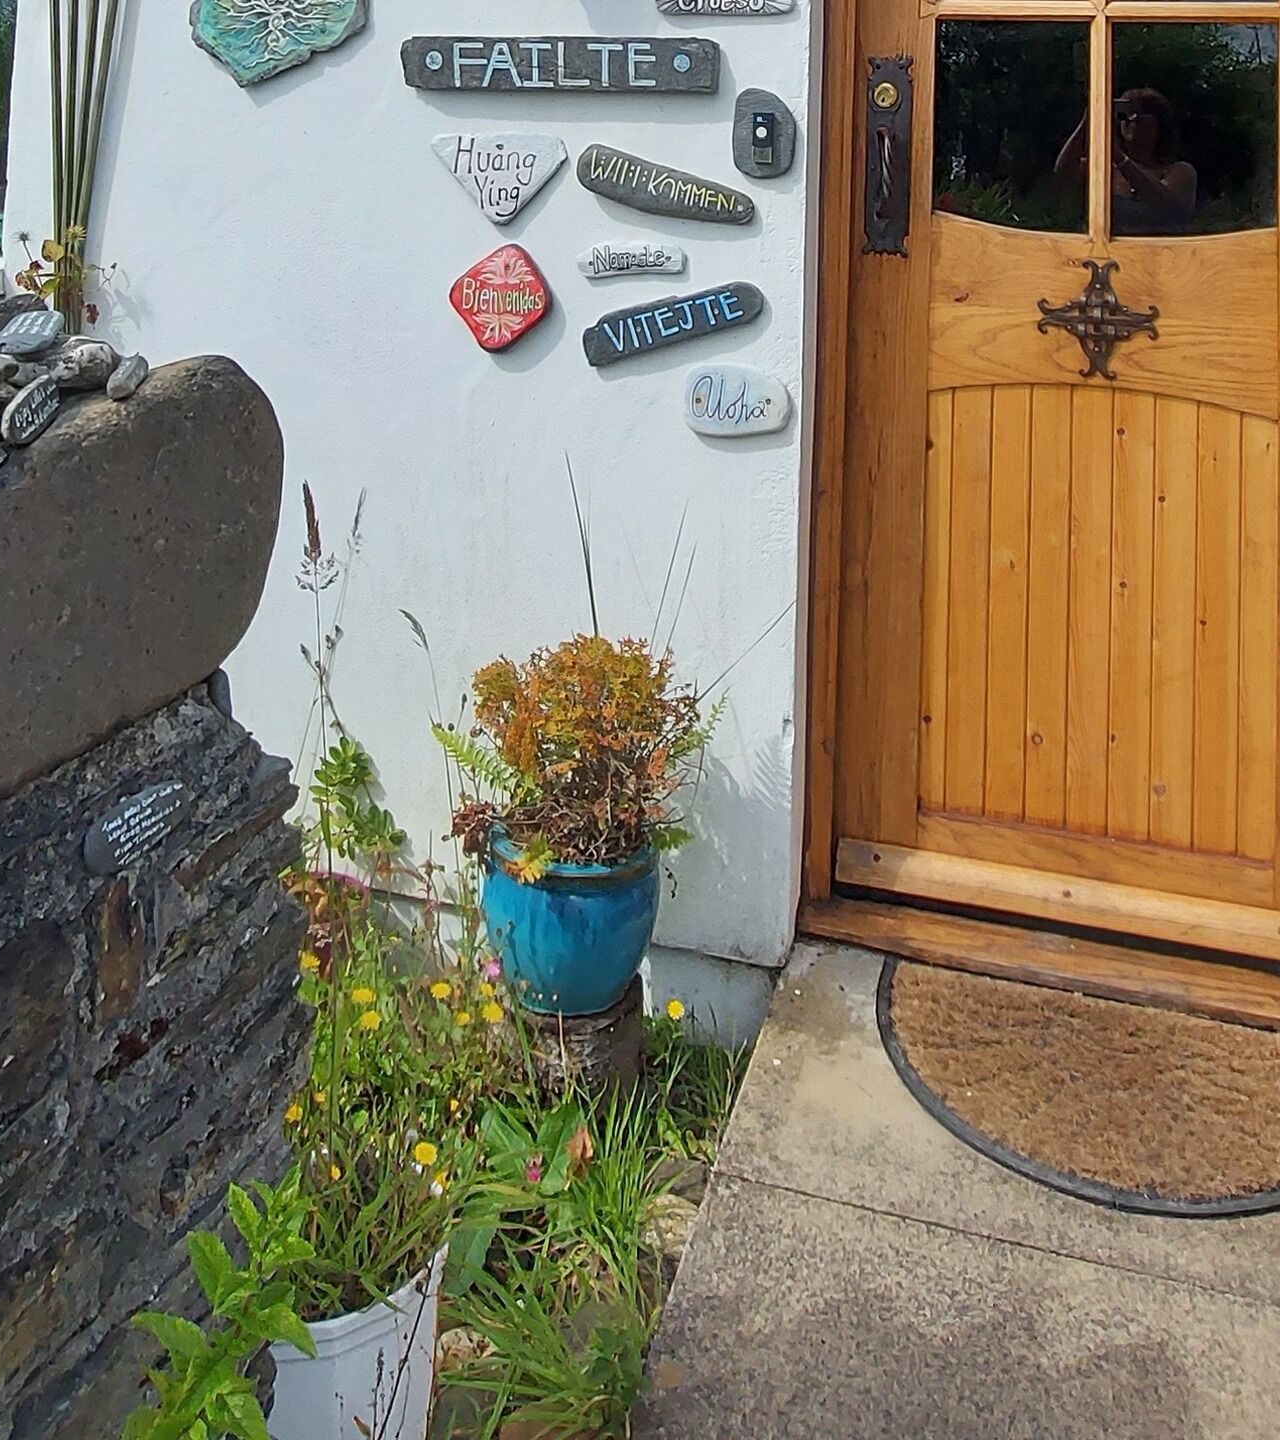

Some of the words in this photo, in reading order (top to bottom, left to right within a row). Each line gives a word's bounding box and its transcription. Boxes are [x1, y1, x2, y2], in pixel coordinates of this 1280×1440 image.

[452, 41, 657, 88] FAILTE
[474, 175, 520, 217] Ying
[592, 246, 666, 276] Namaste
[462, 278, 544, 313] Bienvenidas
[602, 291, 745, 353] VITEJTE
[690, 375, 769, 425] Aloha
